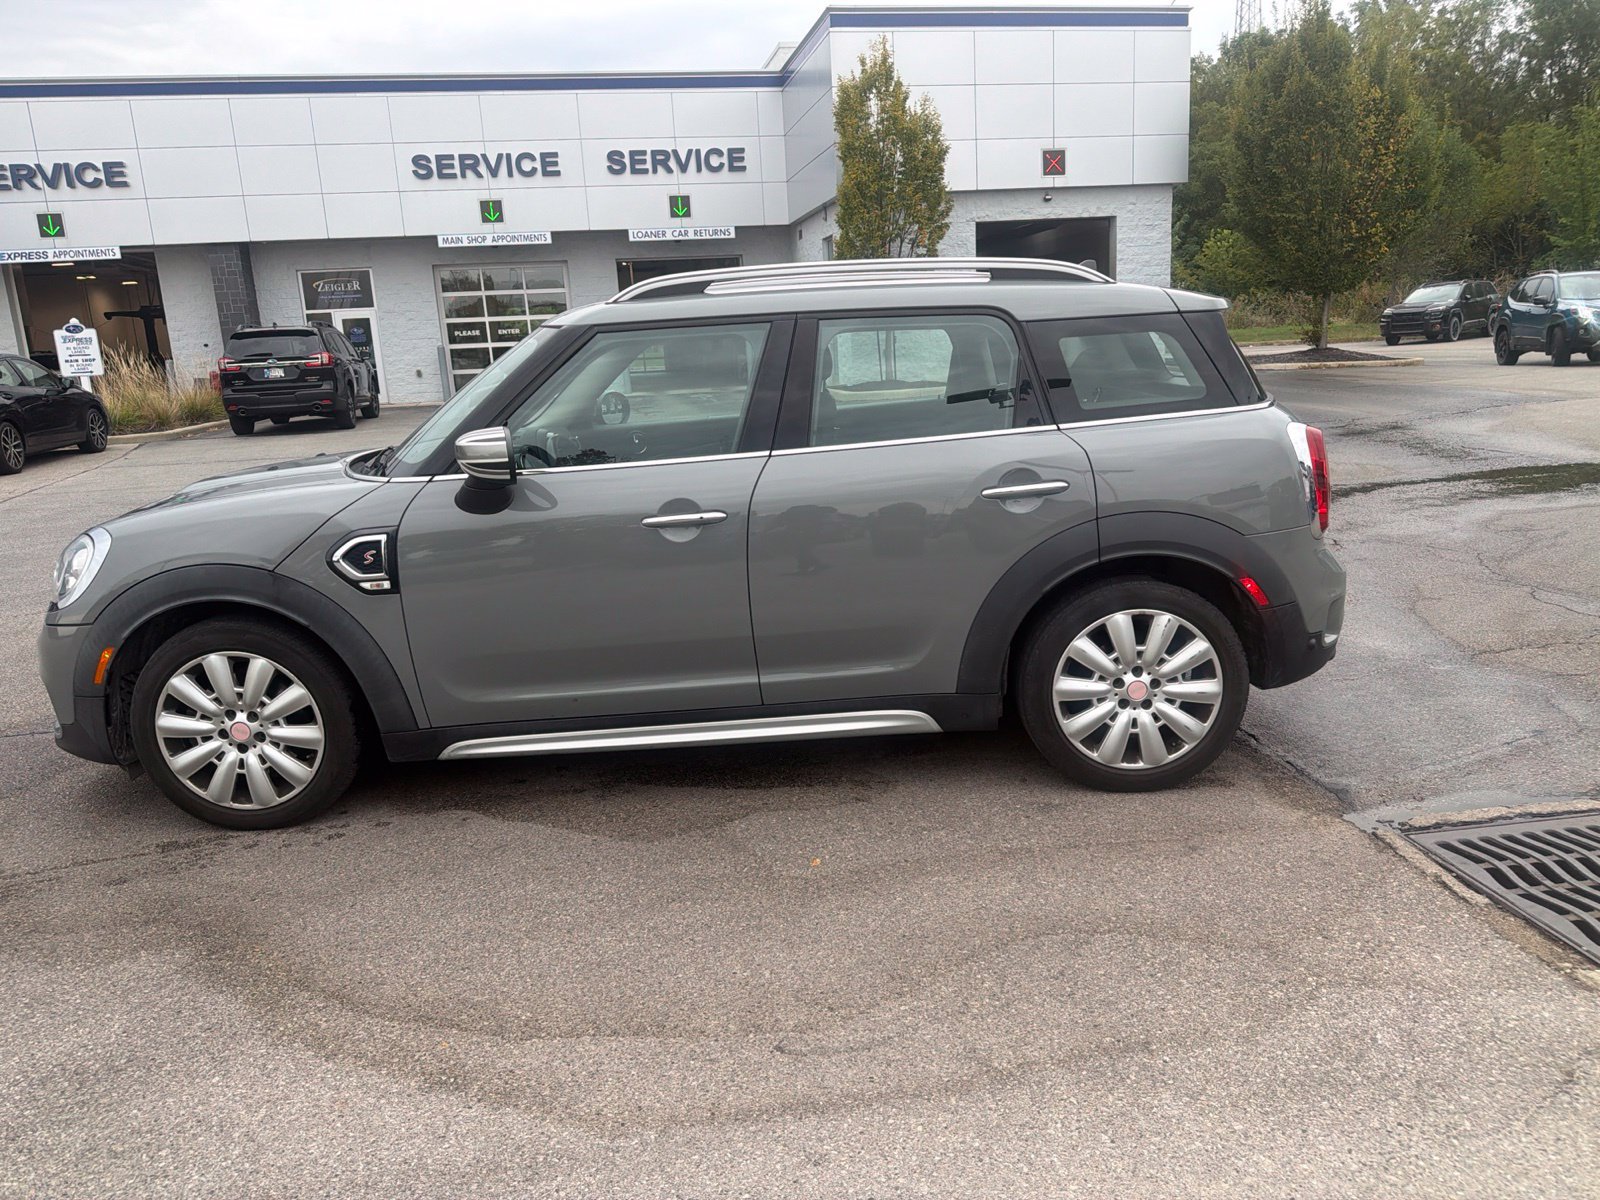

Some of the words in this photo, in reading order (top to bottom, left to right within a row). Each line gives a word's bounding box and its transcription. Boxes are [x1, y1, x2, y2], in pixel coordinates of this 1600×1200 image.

[411, 152, 561, 180] SERVICE
[606, 147, 747, 175] SERVICE
[442, 236, 464, 245] MAIN
[467, 235, 488, 244] SHOP
[491, 233, 548, 243] APPOINTMENTS
[632, 231, 667, 239] LOANER
[671, 230, 690, 238] CAR
[693, 228, 732, 237] RETURNS
[0, 251, 48, 260] EXPRESS
[52, 248, 117, 259] APPOINTMENTS
[317, 281, 361, 292] ZEIGLER
[363, 550, 376, 565] S
